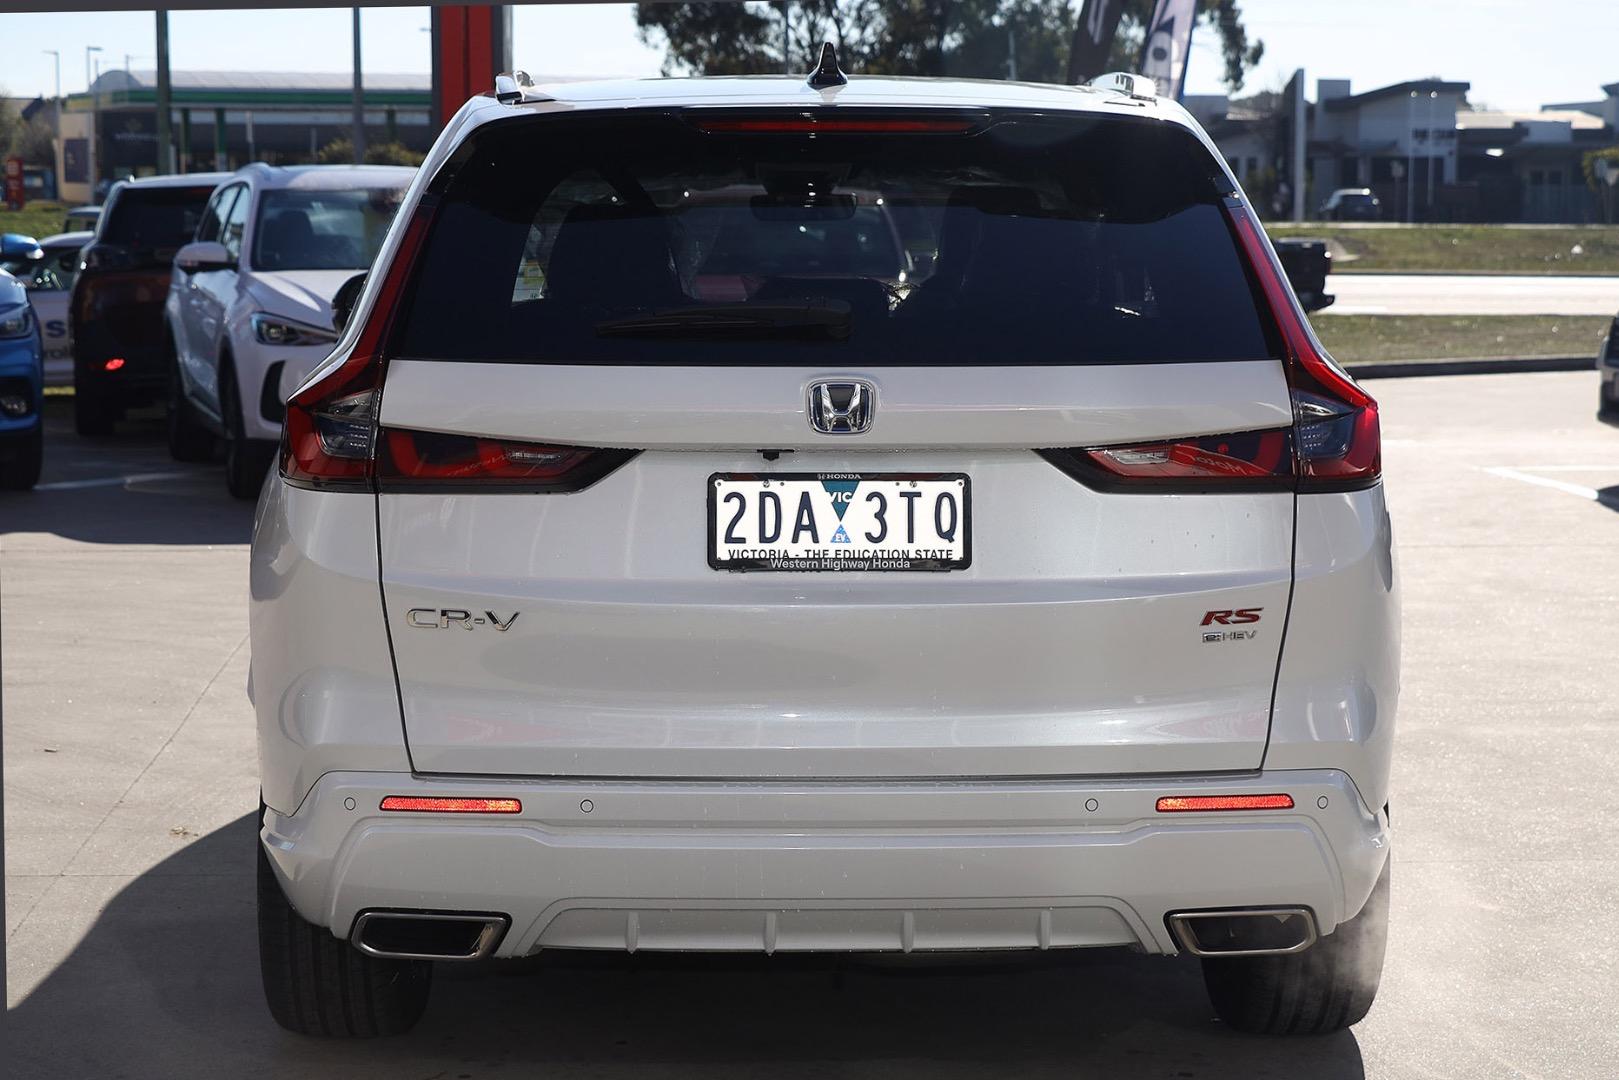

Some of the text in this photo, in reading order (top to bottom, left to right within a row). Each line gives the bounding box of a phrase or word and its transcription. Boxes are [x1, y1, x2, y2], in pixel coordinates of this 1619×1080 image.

[828, 491, 853, 503] VIC
[723, 491, 958, 544] 2DA 3TQ
[728, 549, 791, 559] VICTORIA
[804, 549, 829, 559] THE
[835, 549, 910, 559] EDUCATION
[915, 549, 953, 559] STATE
[770, 559, 911, 571] Western Highway Honda
[406, 608, 520, 632] CR-V
[1200, 607, 1264, 626] RS
